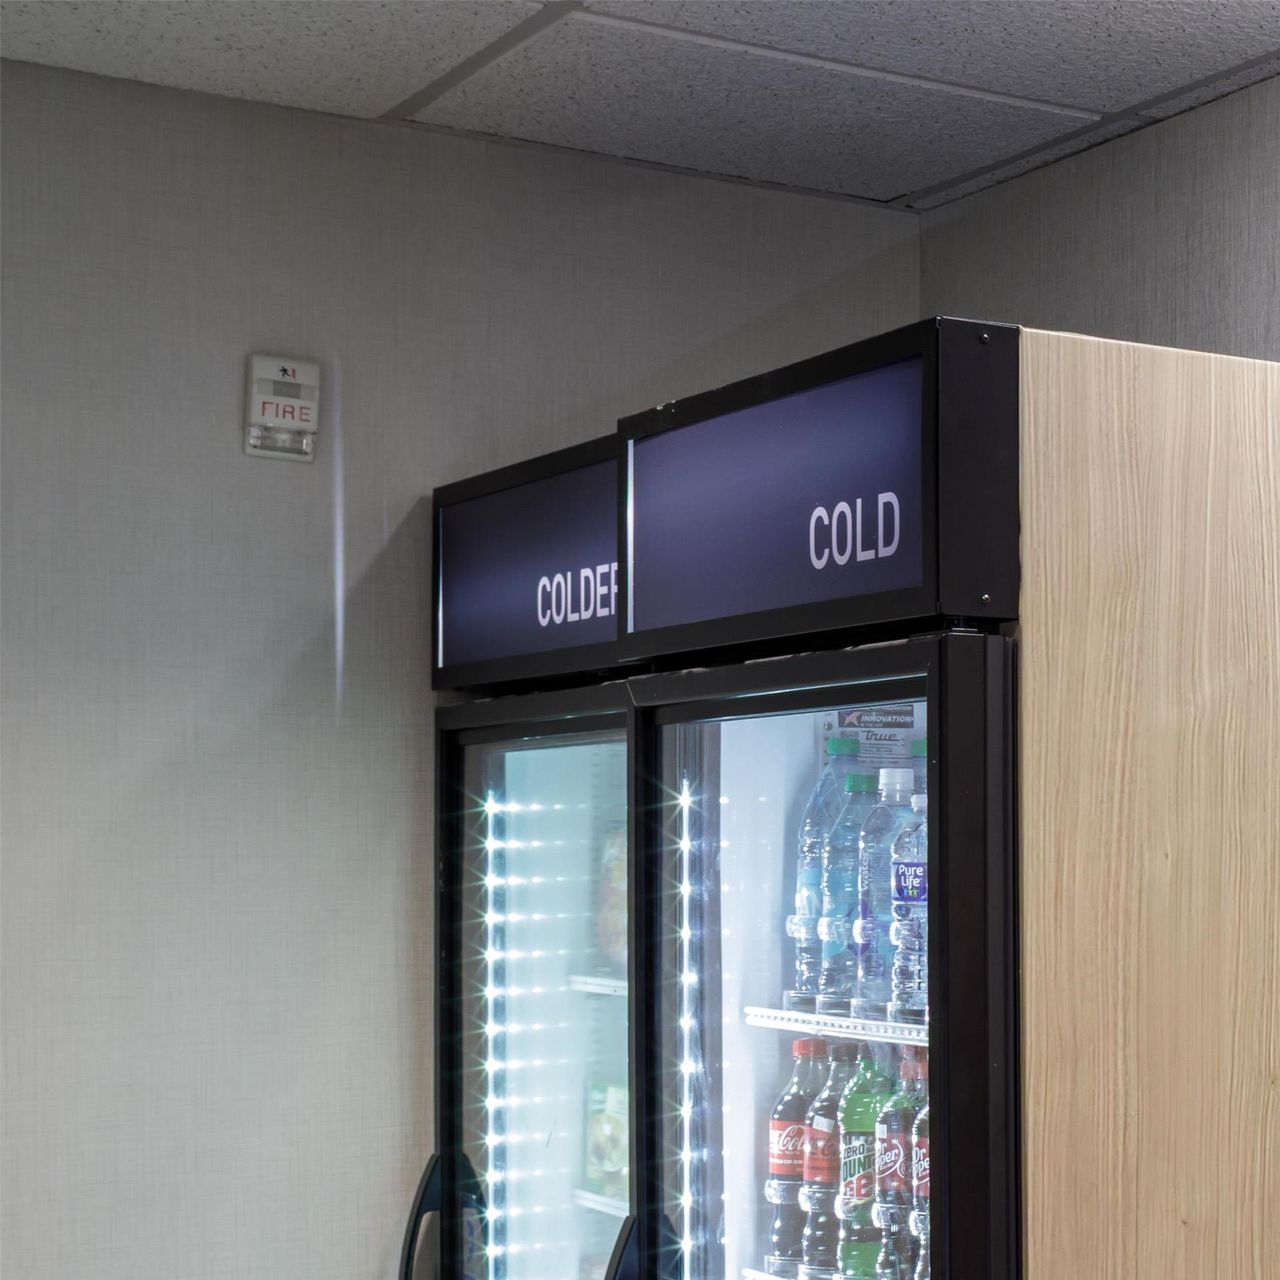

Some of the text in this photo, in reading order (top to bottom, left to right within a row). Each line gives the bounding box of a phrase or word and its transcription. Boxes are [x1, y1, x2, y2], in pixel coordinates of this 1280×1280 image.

[262, 401, 311, 422] FIRE
[810, 492, 900, 570] COLD
[899, 865, 923, 878] Pure
[901, 875, 921, 887] Life
